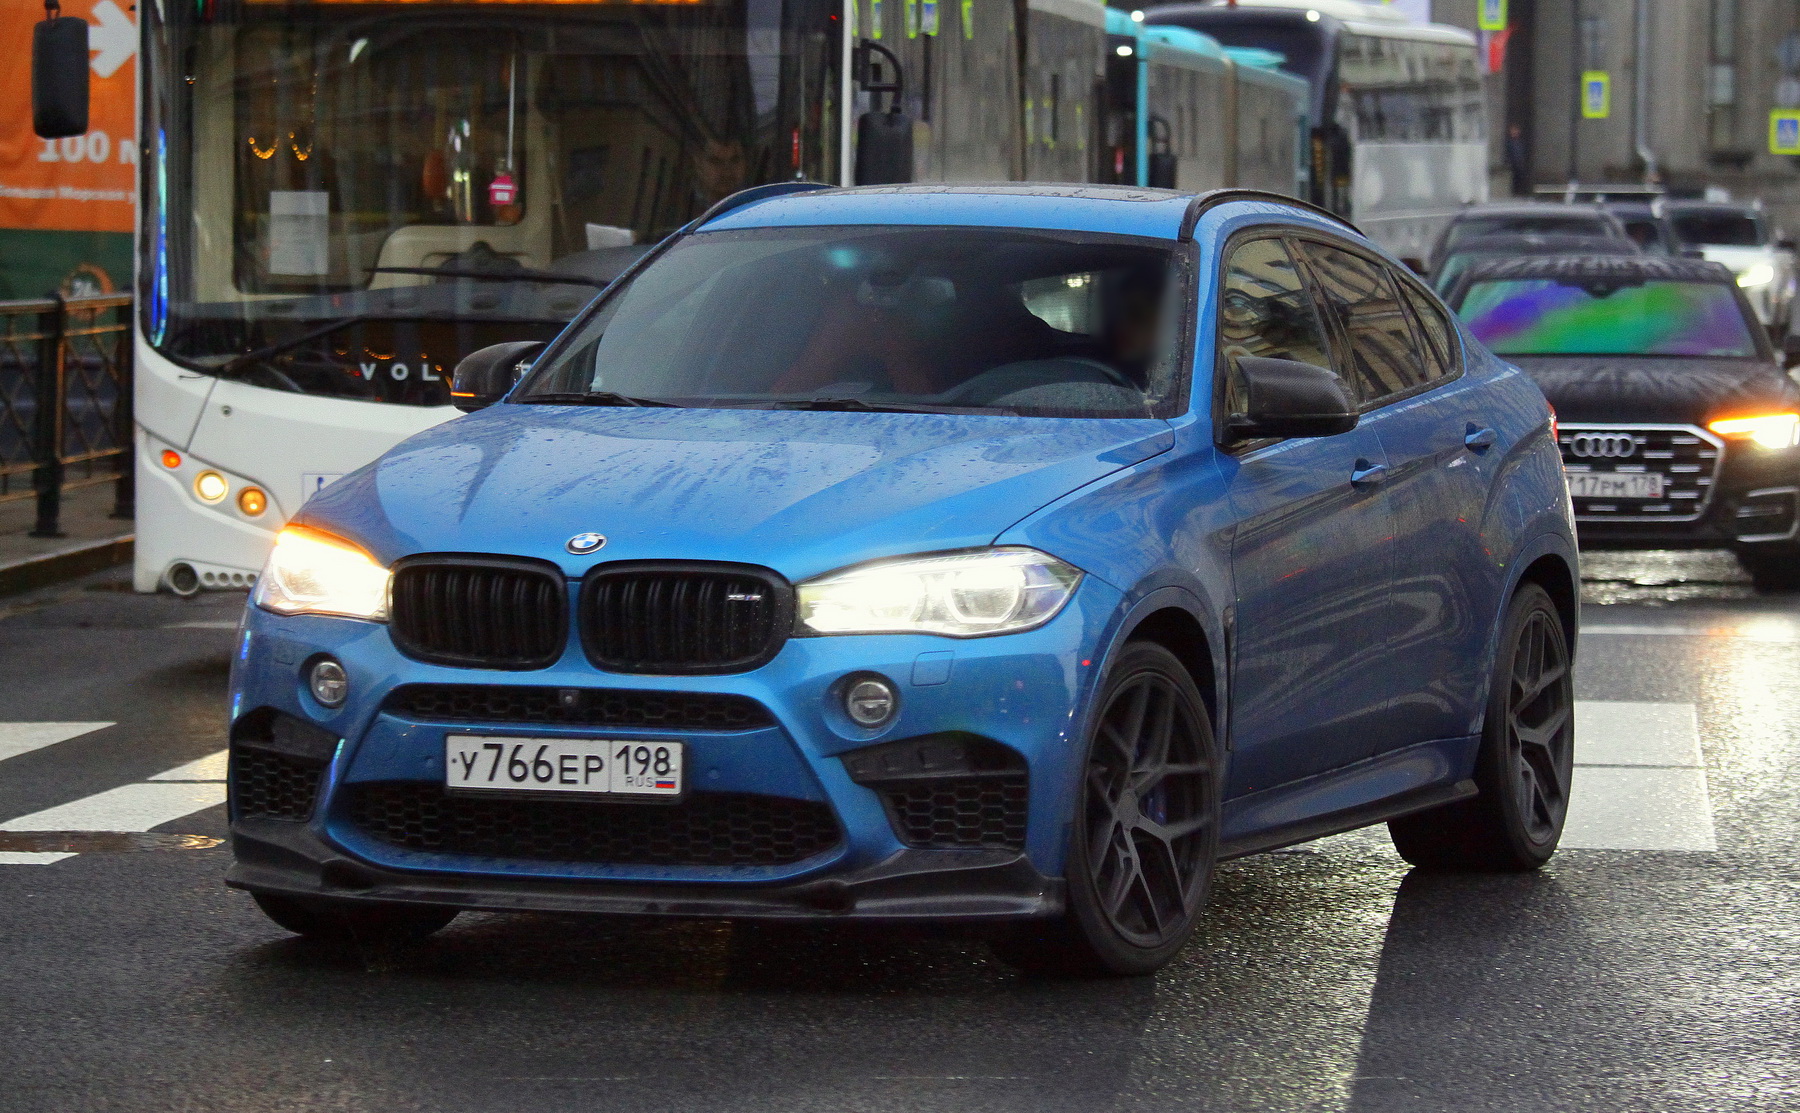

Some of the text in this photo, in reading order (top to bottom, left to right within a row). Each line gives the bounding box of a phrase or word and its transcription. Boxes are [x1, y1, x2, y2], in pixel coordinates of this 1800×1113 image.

[37, 130, 111, 163] 100
[360, 362, 440, 381] VOL
[459, 743, 671, 785] У766ЕР 198
[625, 775, 654, 788] RUS
